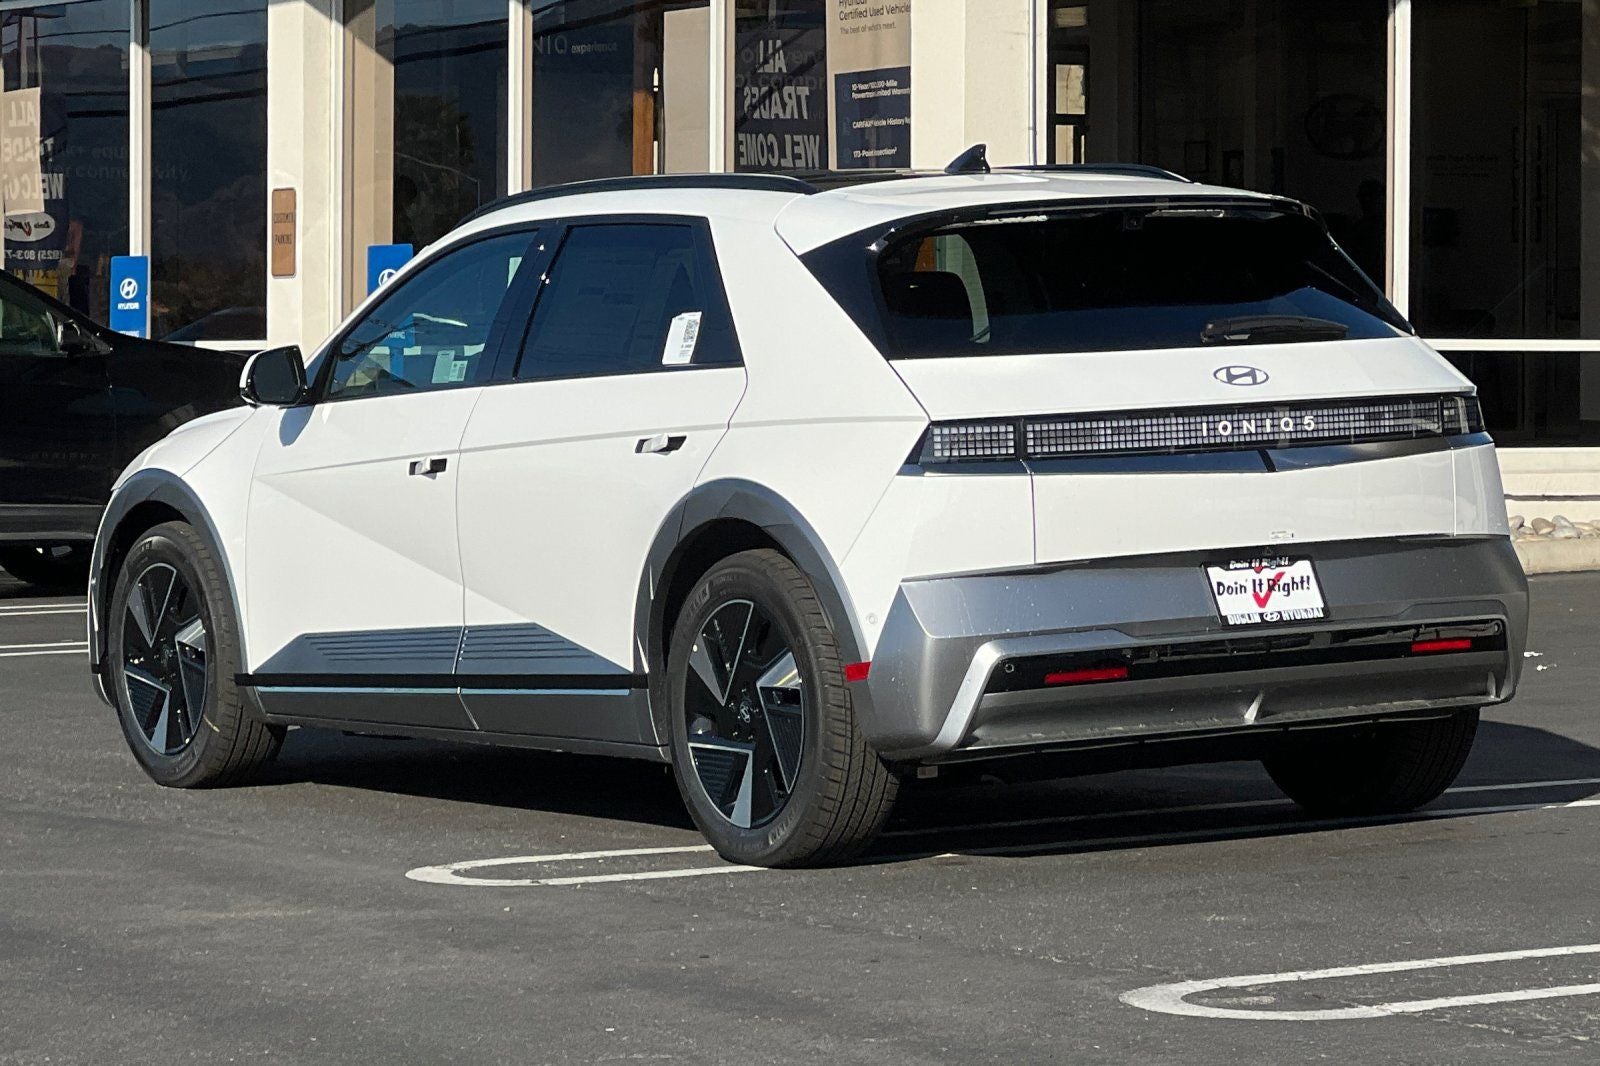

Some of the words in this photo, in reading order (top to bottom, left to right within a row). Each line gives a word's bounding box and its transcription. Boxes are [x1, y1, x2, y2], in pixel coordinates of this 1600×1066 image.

[839, 8, 868, 21] Certified
[869, 5, 884, 17] Used
[885, 3, 911, 15] Vehicle
[534, 35, 567, 55] NIQ
[571, 40, 617, 55] experience
[1252, 578, 1264, 594] It
[1267, 575, 1311, 597] Right!
[1227, 611, 1262, 626] DUBLIN
[1281, 607, 1325, 622] HYUNDAI
